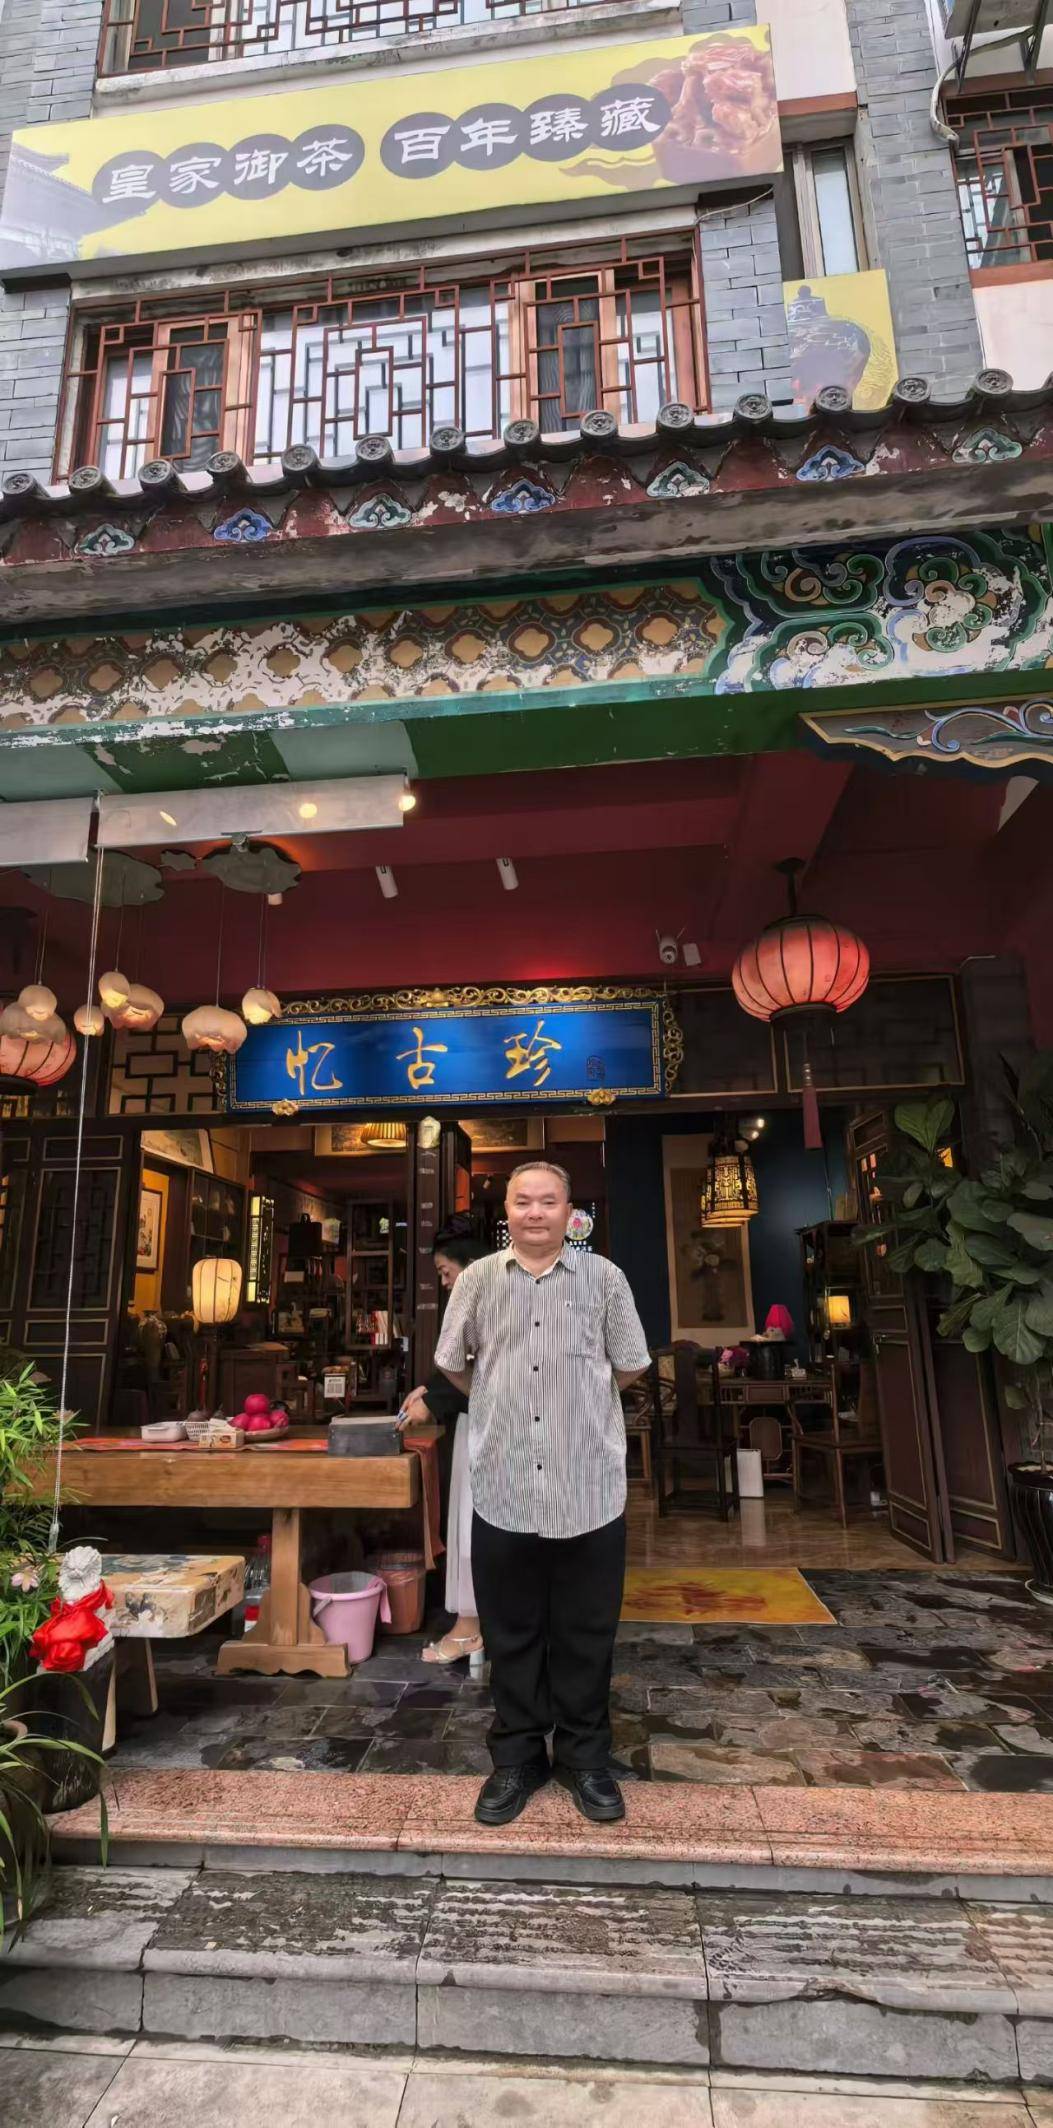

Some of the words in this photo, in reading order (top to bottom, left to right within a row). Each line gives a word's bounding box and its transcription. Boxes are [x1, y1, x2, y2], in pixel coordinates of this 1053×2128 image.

[102, 138, 353, 203] 皇家御茶
[394, 97, 661, 164] 百年臻藏
[286, 1020, 562, 1095] 忆古珍
